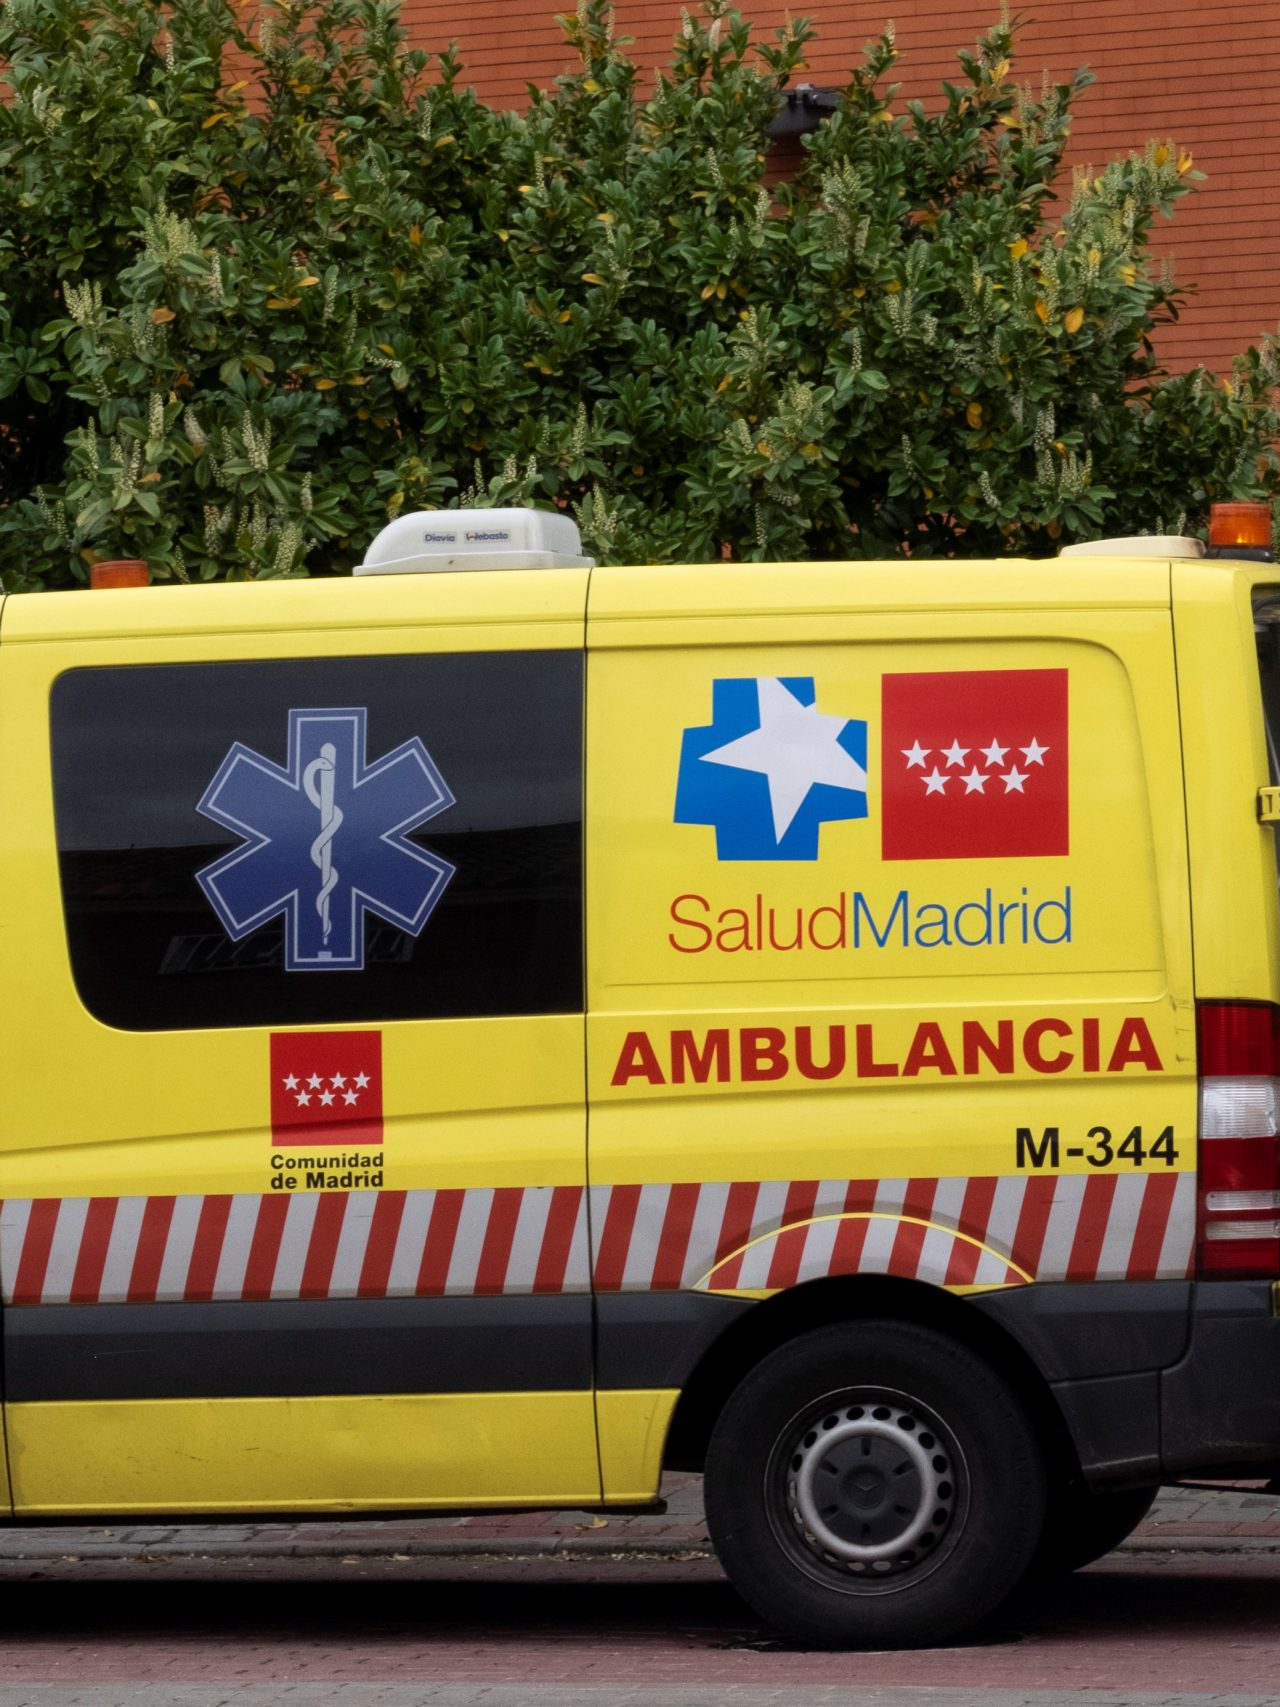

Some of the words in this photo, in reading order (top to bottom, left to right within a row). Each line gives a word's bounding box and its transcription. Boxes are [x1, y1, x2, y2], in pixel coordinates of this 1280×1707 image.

[667, 885, 1073, 954] SaludMadrid
[610, 1016, 1164, 1087] AMBULANCIA
[270, 1152, 384, 1170] Comunidad
[1016, 1125, 1179, 1168] M-344
[270, 1172, 297, 1189] de
[305, 1170, 384, 1189] Madrid
